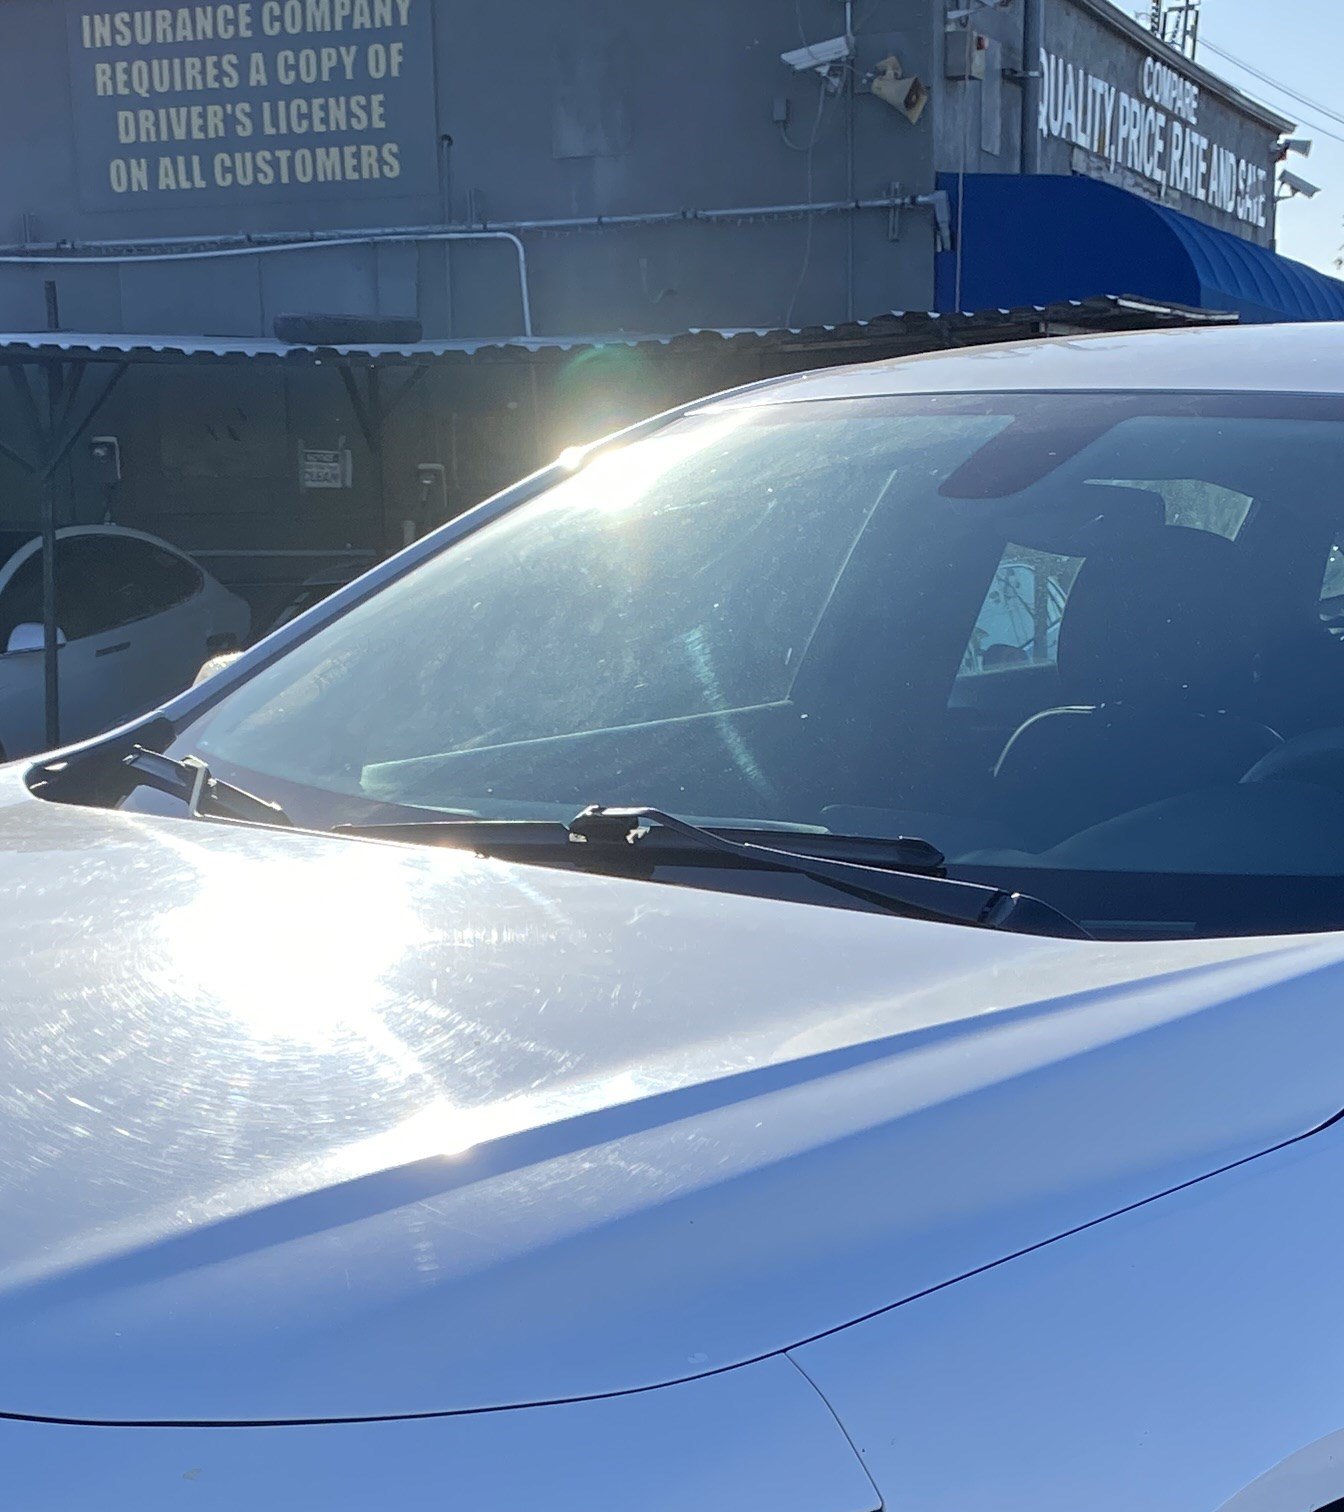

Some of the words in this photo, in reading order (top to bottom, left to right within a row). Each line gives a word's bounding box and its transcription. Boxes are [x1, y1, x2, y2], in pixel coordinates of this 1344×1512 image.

[81, 3, 253, 49] INSURANCE
[261, 0, 411, 37] COMPANY
[95, 53, 240, 97] REQUIRES
[249, 52, 268, 87] A
[277, 46, 357, 86] COPY
[367, 42, 404, 80] OF
[1143, 56, 1200, 126] COMPARE
[117, 102, 254, 144] DRIVER'S
[262, 94, 387, 136] LICENSE
[109, 158, 148, 193] ON
[158, 155, 207, 191] ALL
[214, 143, 401, 187] CUSTOMERS
[1117, 91, 1167, 197] PRICE,
[1169, 120, 1208, 201] RATE
[1207, 143, 1236, 213] AND
